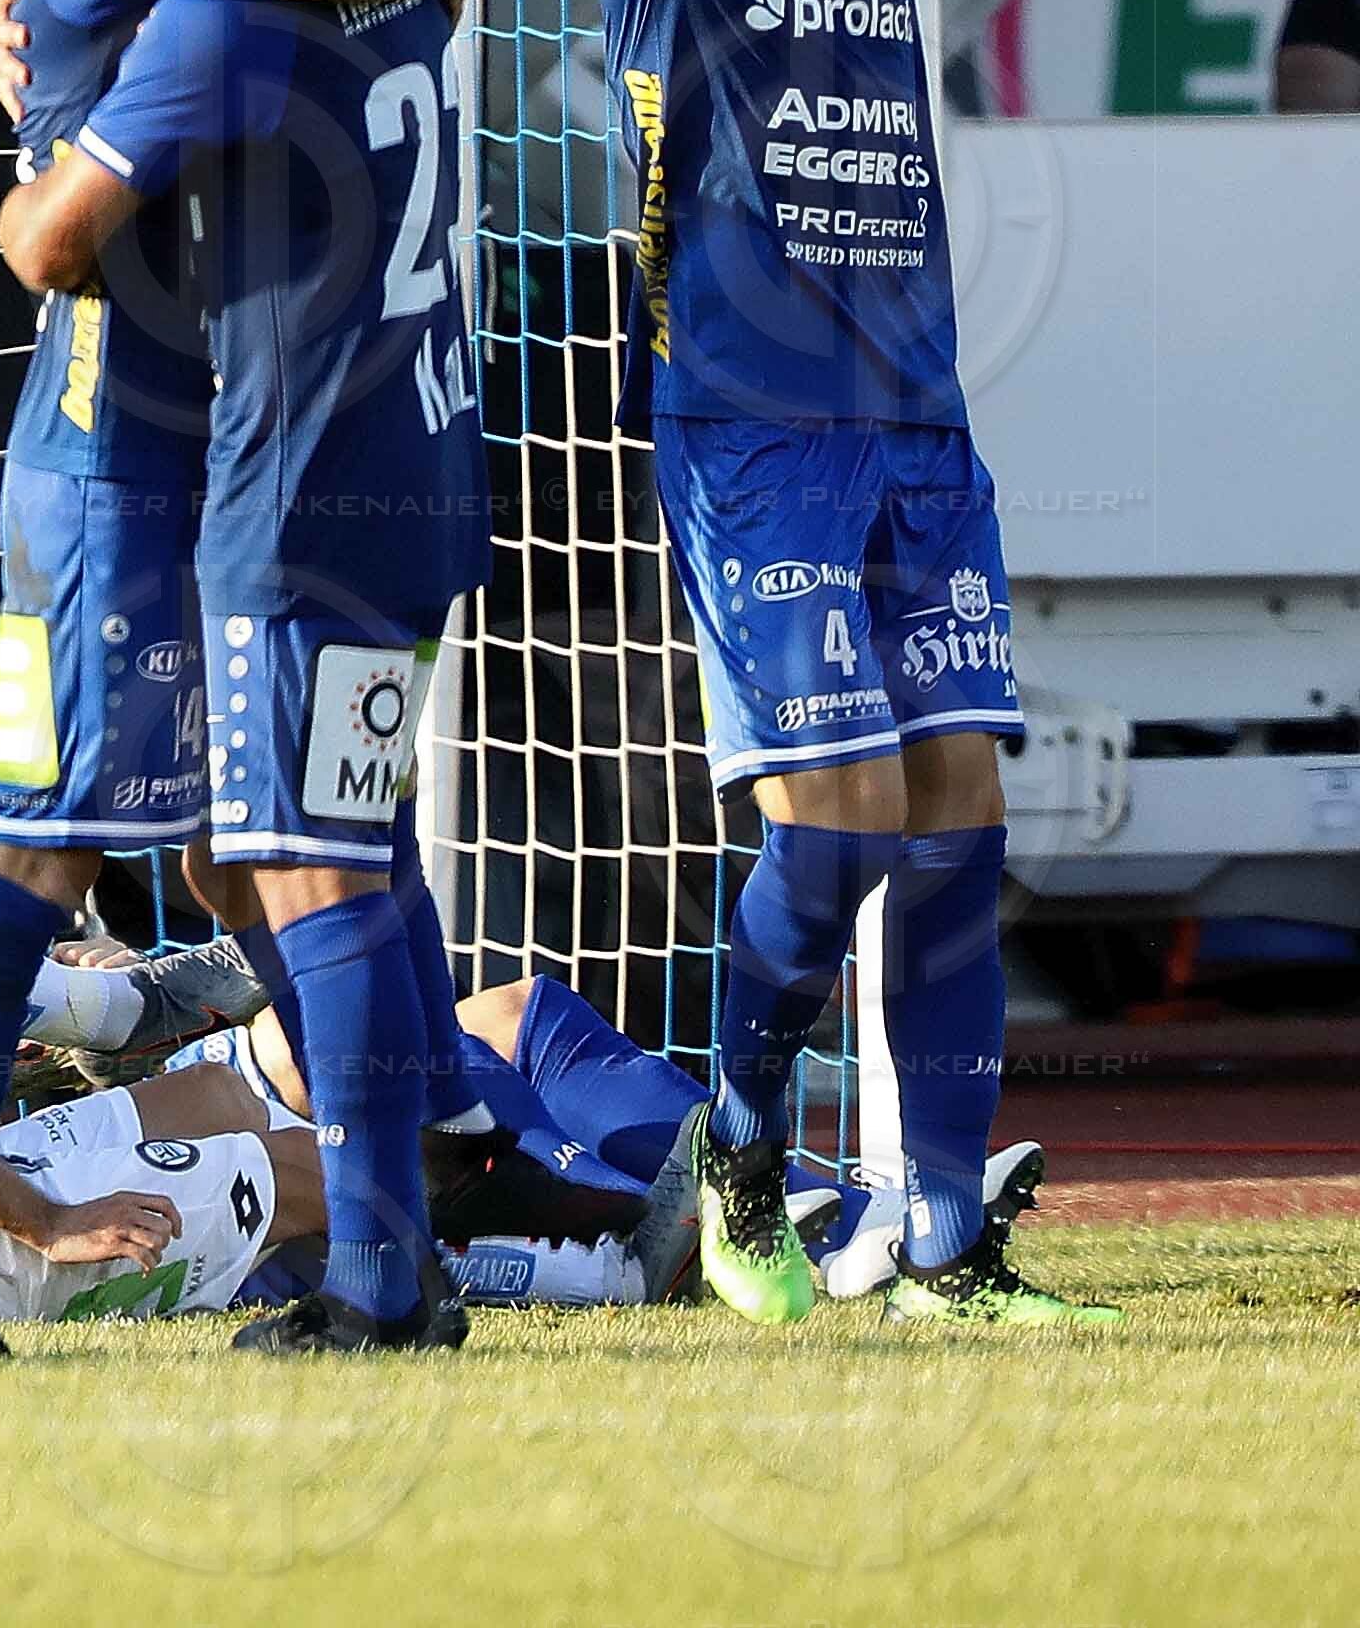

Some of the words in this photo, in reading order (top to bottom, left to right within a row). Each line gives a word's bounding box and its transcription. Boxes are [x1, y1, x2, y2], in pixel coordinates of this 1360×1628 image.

[763, 142, 897, 188] EGGER
[784, 239, 845, 267] SPEED
[761, 569, 808, 597] KIA
[822, 607, 858, 677] 4
